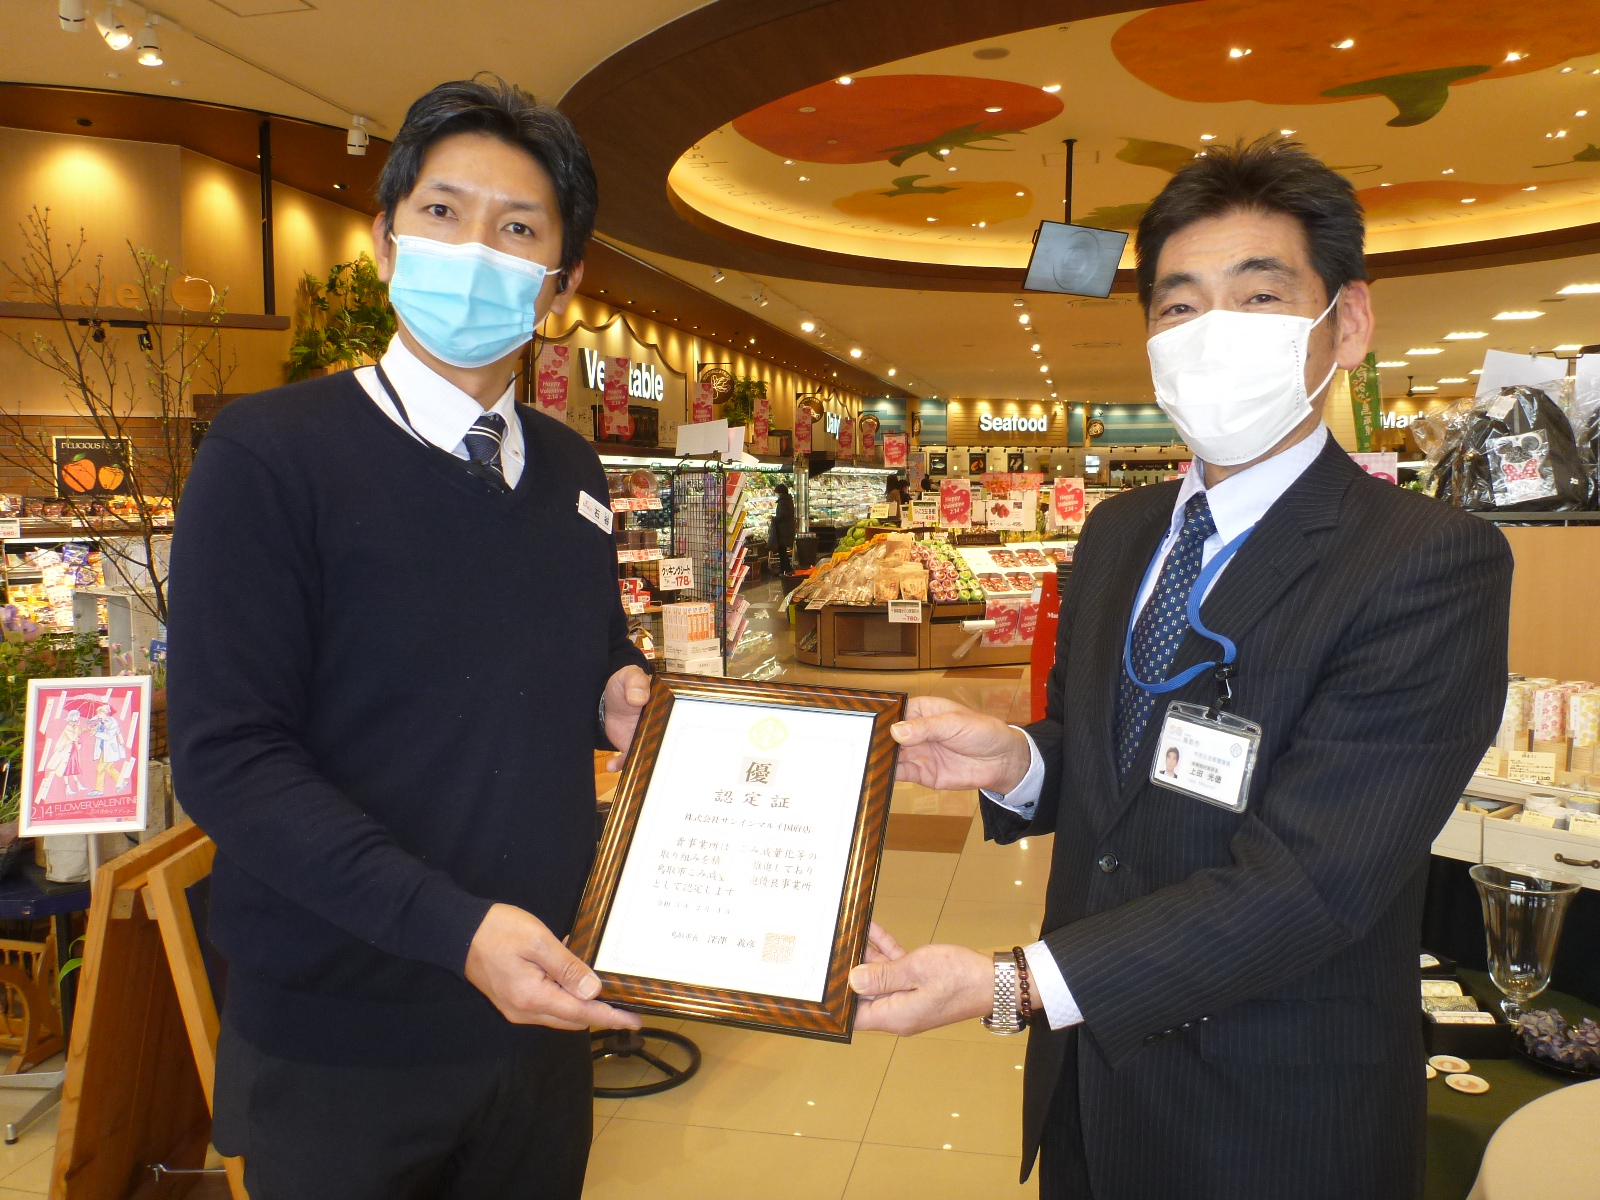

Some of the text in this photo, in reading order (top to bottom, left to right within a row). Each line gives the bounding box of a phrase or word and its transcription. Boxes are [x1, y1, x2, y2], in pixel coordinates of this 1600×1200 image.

[584, 347, 664, 402] Vetable
[979, 412, 1048, 432] Seafood
[662, 565, 690, 576] クッキングシート
[675, 575, 690, 587] 178
[745, 761, 772, 784] 優
[1189, 768, 1204, 778] 上田
[30, 805, 54, 820] 2.14
[54, 800, 92, 813] FLOWER
[92, 795, 138, 808] VALENTINE
[714, 789, 790, 808] 認定証
[652, 879, 735, 896] として認定します
